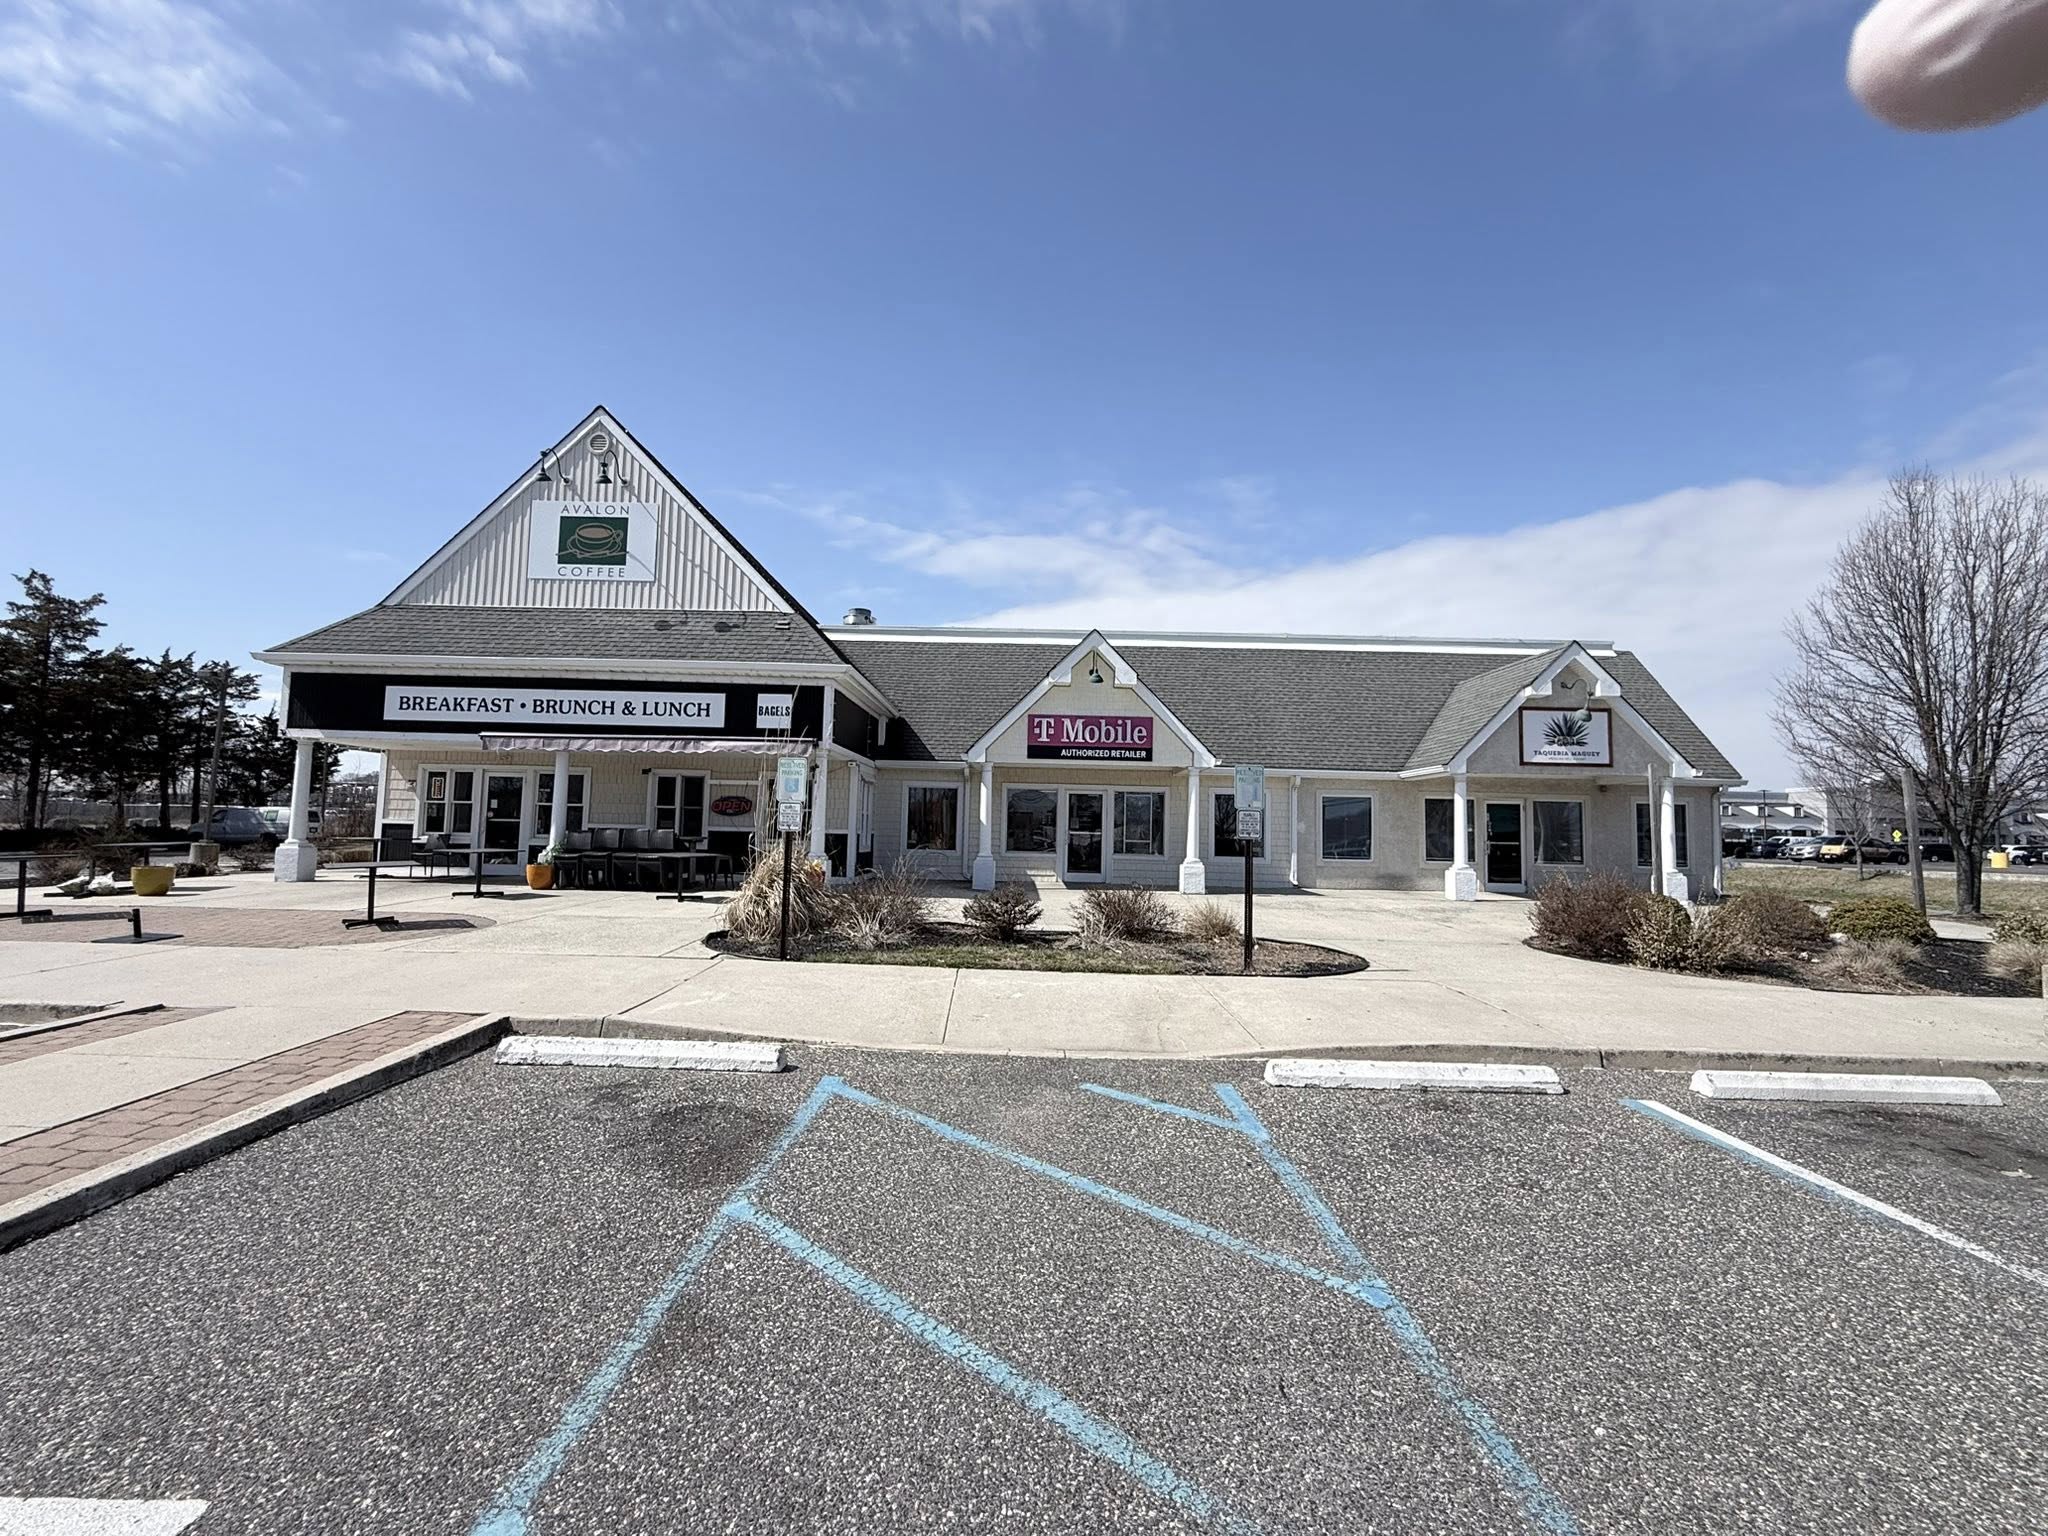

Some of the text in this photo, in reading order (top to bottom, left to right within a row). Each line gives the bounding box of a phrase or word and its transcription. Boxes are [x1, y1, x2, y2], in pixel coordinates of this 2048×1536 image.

[561, 505, 630, 515] AVALON
[557, 566, 625, 578] COFFEE
[398, 695, 712, 718] BREAKFAST BRUNCH & LUNCH
[758, 705, 791, 717] BAGELS
[1061, 718, 1148, 745] Mobile
[1060, 748, 1147, 759] AUTHORIZED RETAILER
[712, 801, 751, 811] OPEN
